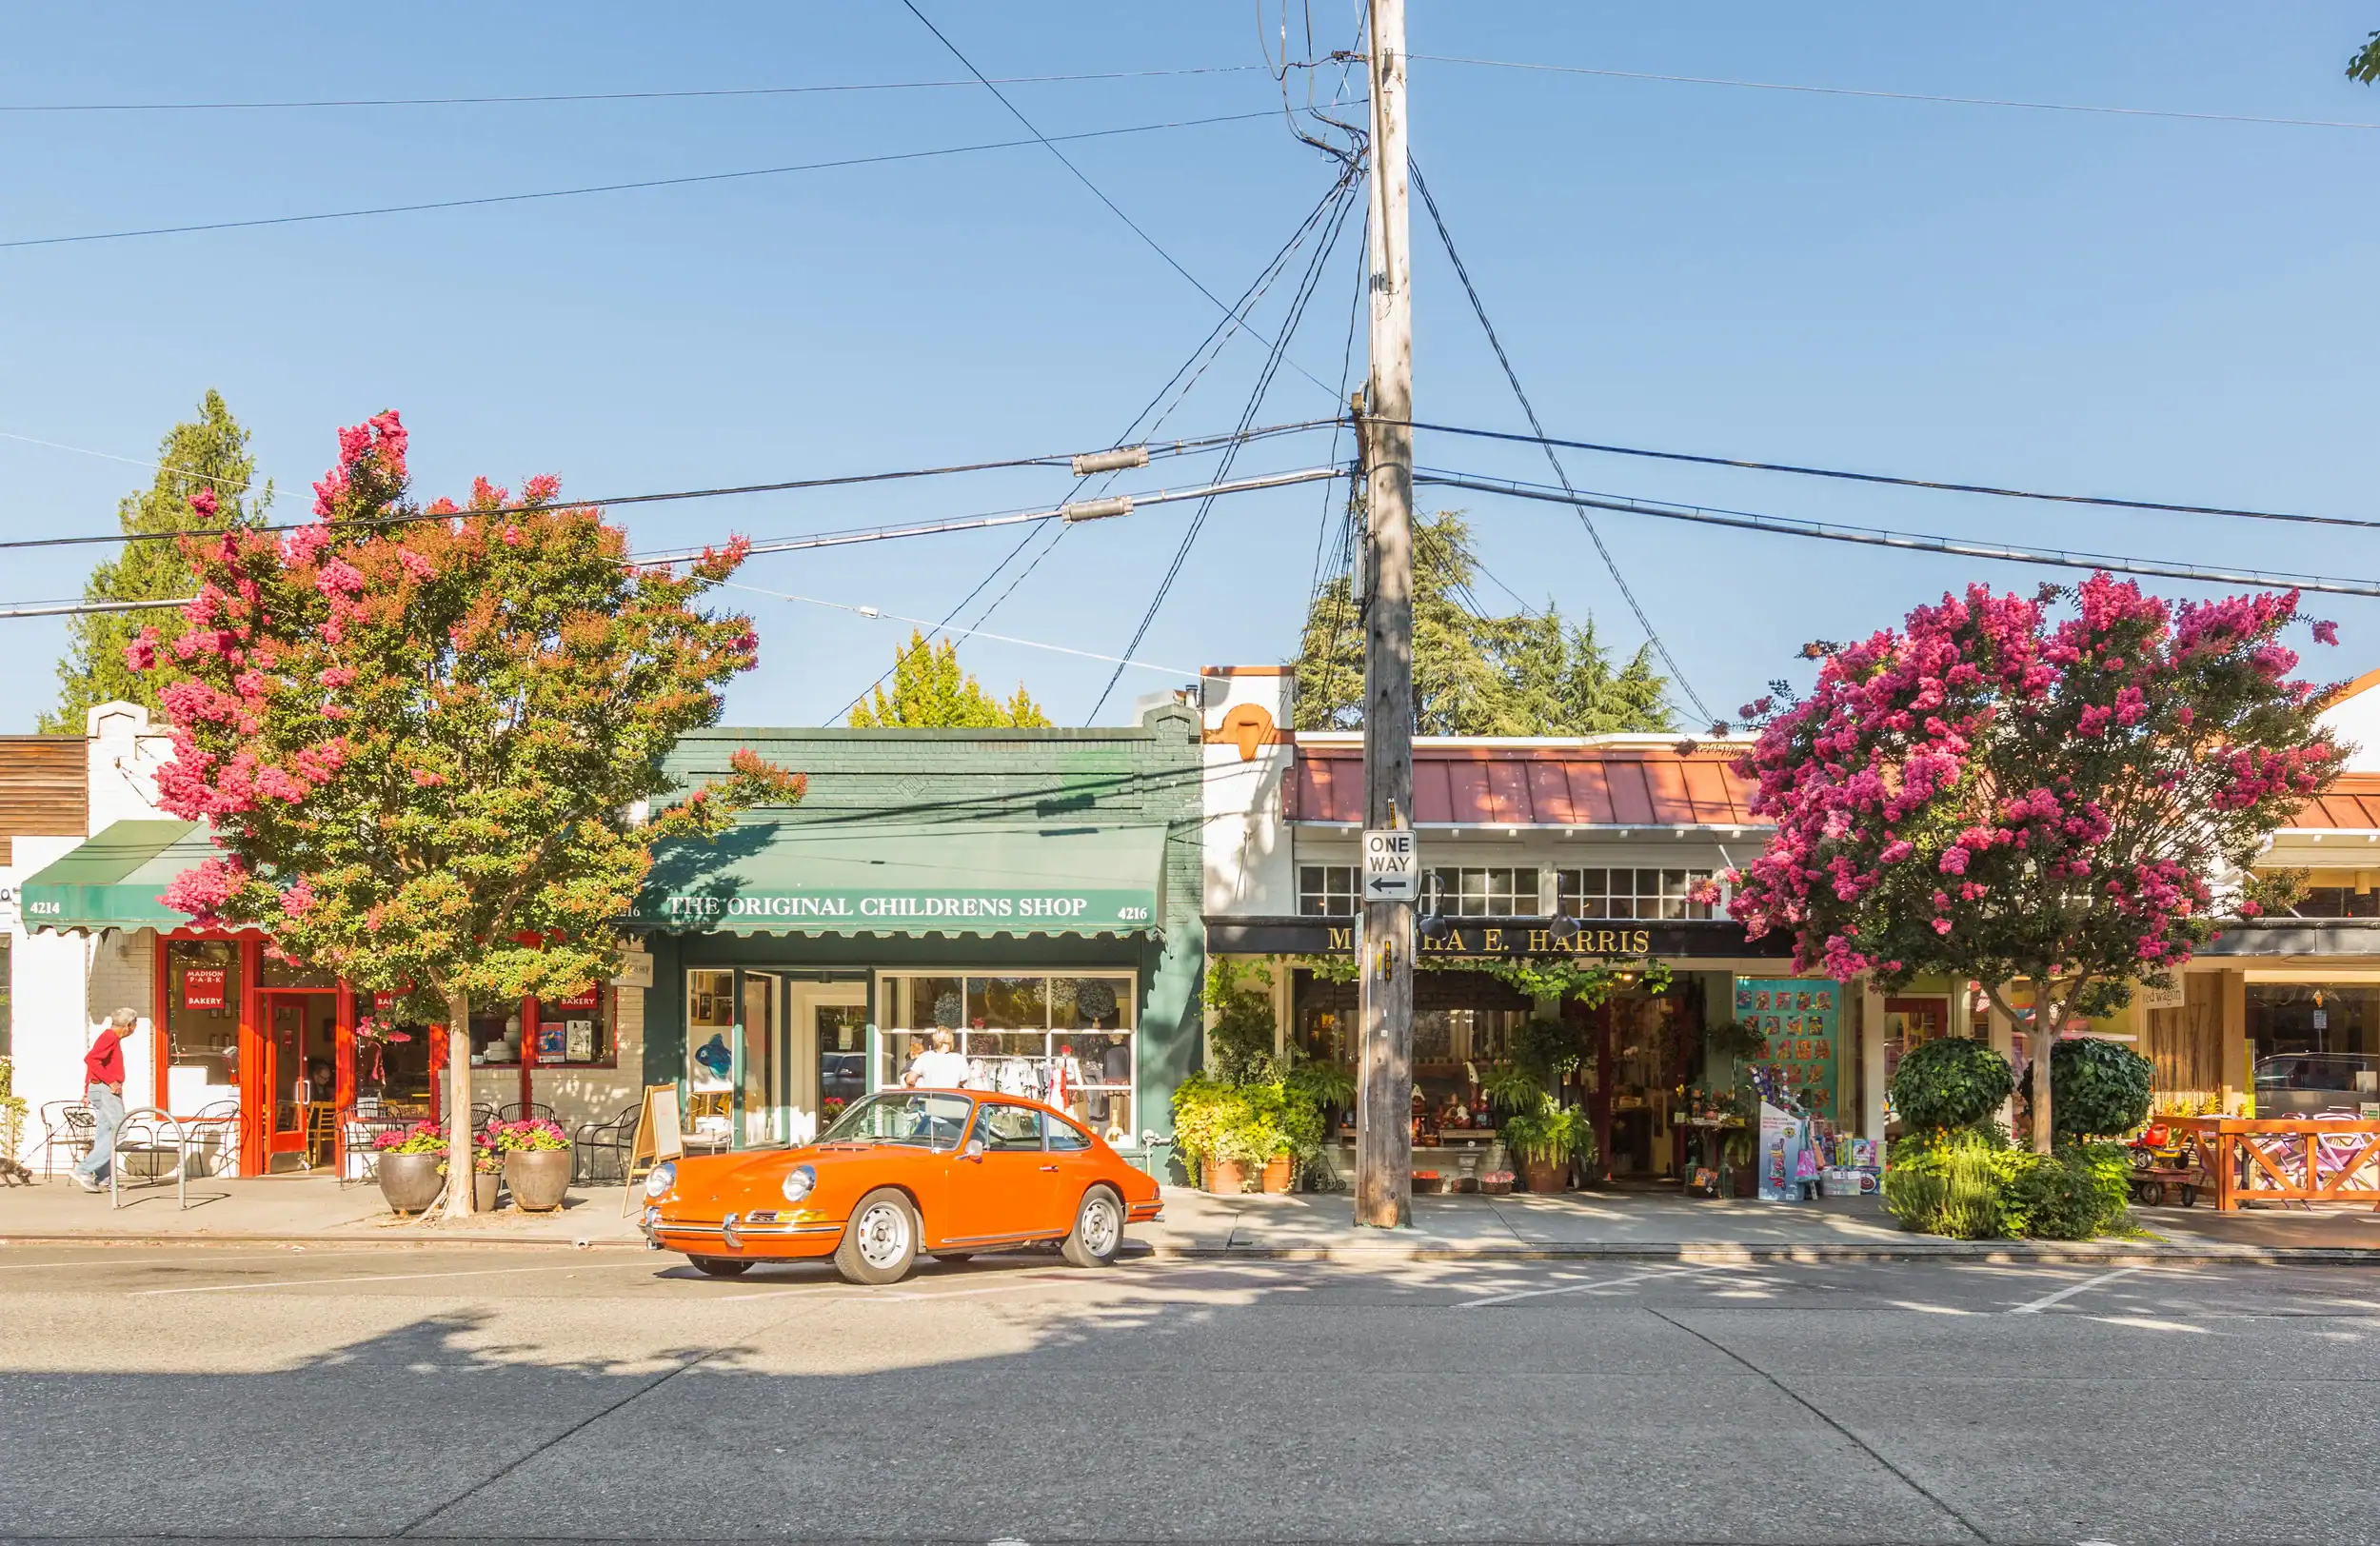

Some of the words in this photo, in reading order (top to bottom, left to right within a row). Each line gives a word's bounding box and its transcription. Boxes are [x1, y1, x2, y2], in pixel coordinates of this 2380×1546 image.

[1370, 837, 1410, 853] ONE
[1370, 857, 1410, 872] WAY
[30, 902, 60, 914] 4214
[614, 905, 641, 917] 216
[666, 898, 720, 915] THE
[727, 898, 853, 916] ORIGINAL
[860, 898, 1012, 916] CHILDRENS
[1019, 898, 1088, 917] SHOP
[1118, 907, 1148, 920] 4216
[1482, 928, 1510, 951] E.
[1527, 928, 1651, 953] HARRIS
[2155, 990, 2181, 1005] wagon
